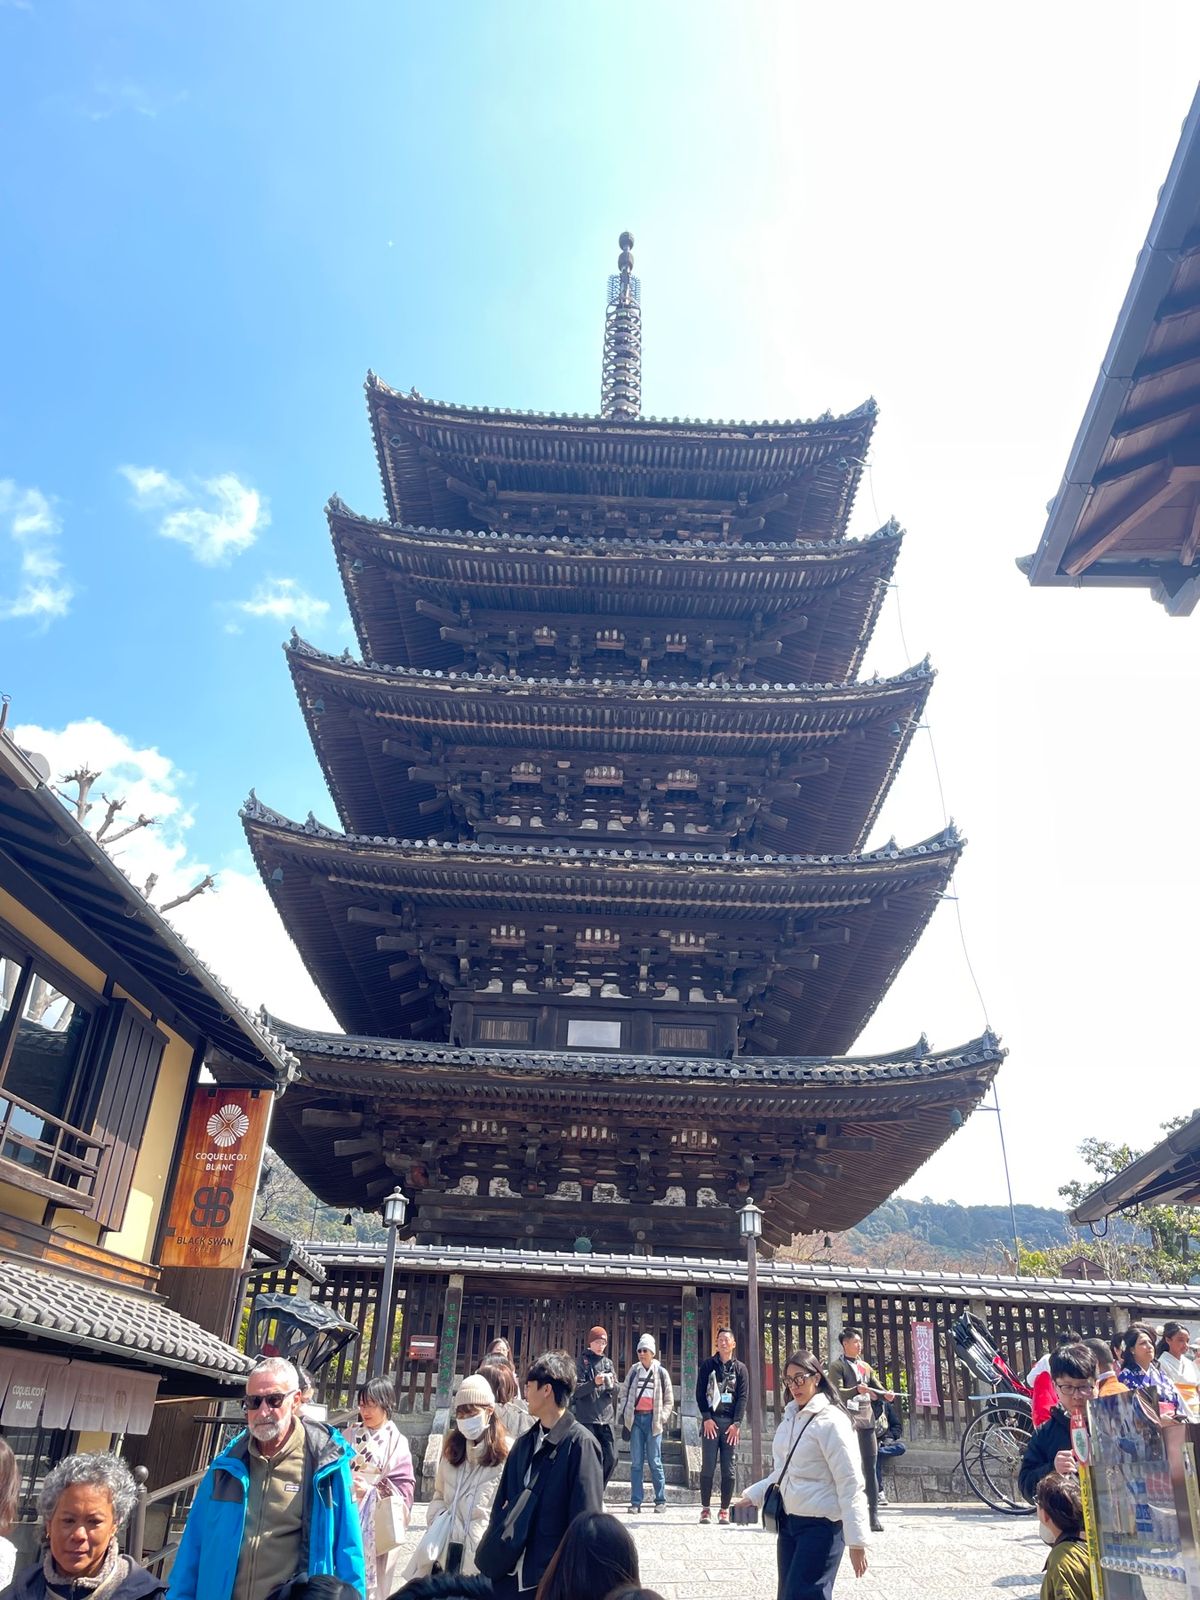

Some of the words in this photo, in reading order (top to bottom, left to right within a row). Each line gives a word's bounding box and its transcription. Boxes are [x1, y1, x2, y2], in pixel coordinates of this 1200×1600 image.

[195, 1152, 248, 1161] COQUELICOT
[205, 1163, 234, 1171] BLANC
[176, 1236, 206, 1245] BLACK
[207, 1237, 234, 1246] SWAN
[915, 1325, 931, 1403] 無火災推進日
[12, 1385, 45, 1397] COQUELICOT
[15, 1400, 33, 1410] BLANC
